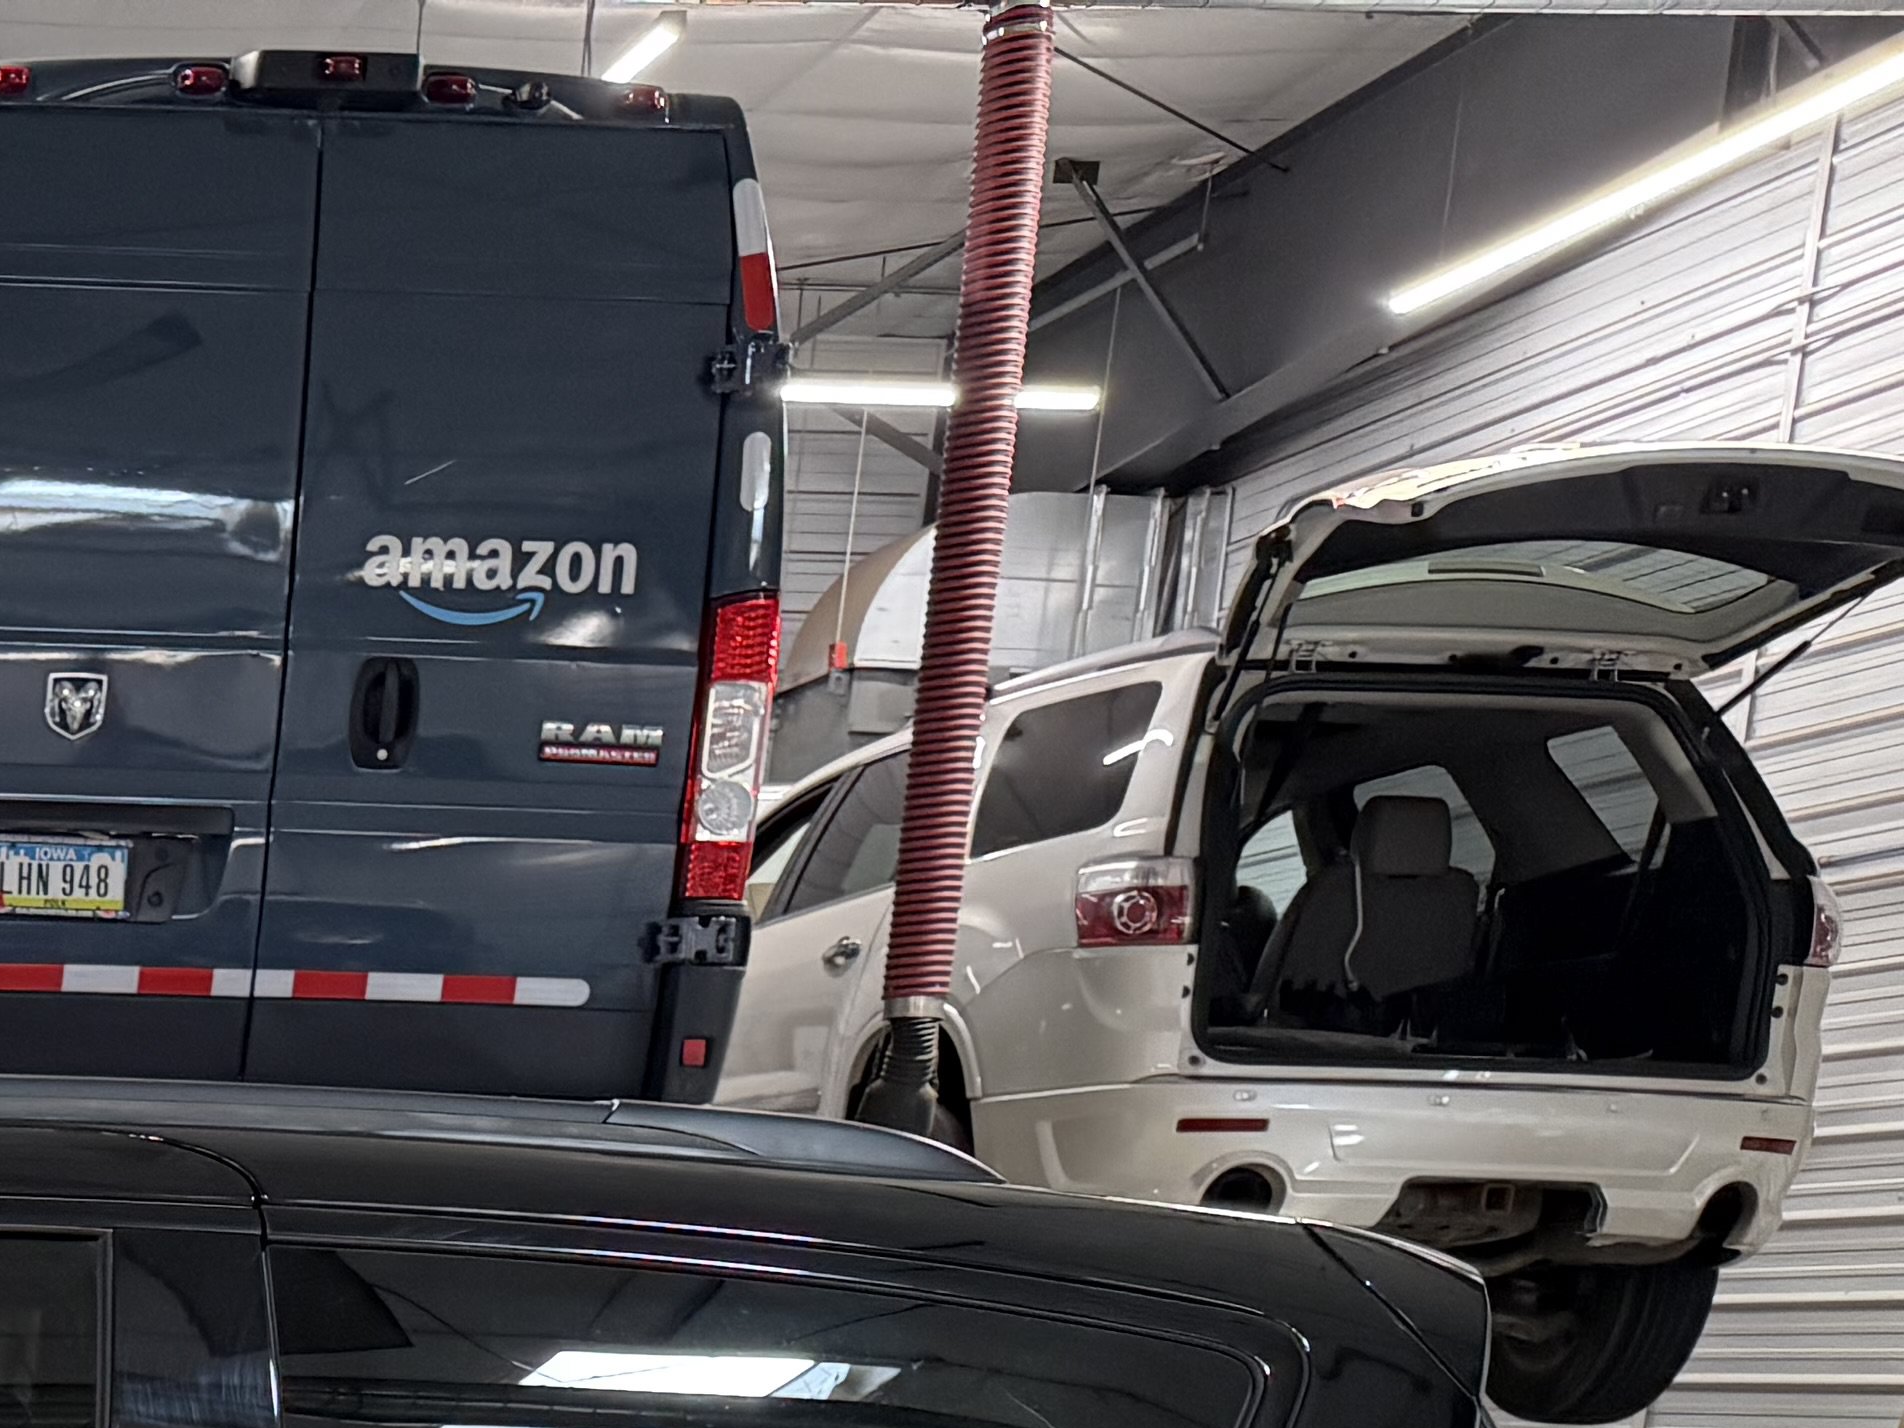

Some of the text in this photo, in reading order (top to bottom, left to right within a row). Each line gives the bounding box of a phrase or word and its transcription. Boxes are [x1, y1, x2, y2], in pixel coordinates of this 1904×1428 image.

[363, 534, 637, 595] amazon
[541, 720, 663, 746] RAM
[35, 848, 77, 860] IOWA
[0, 861, 109, 897] LHN 948
